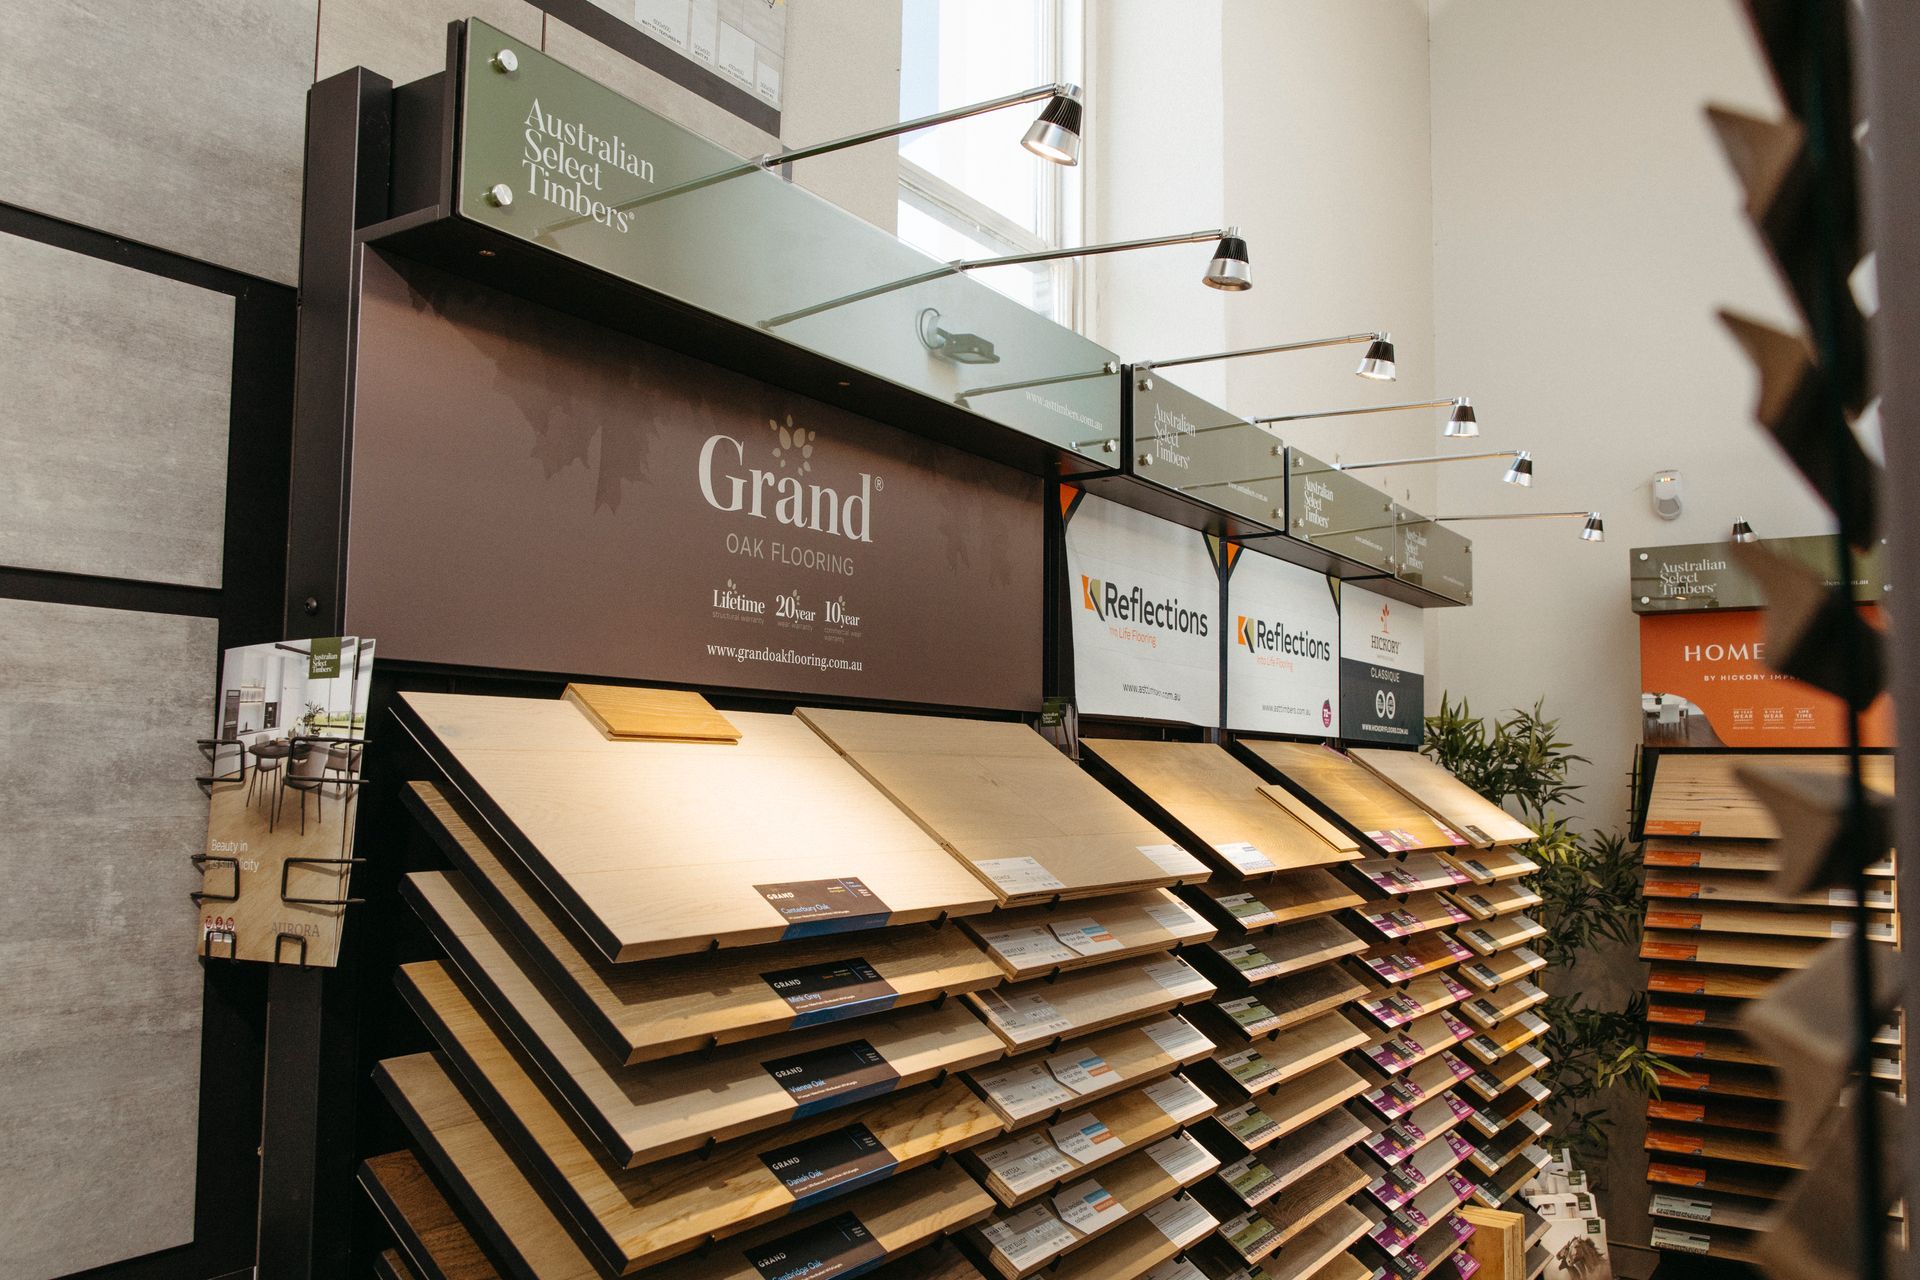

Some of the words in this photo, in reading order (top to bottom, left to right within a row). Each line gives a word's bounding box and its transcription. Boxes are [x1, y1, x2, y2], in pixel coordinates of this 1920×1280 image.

[524, 98, 655, 184] Australian
[525, 129, 603, 191] Select
[1154, 403, 1196, 438] Australian
[1154, 421, 1179, 449] Select
[1304, 475, 1334, 501] Australian
[1304, 491, 1322, 511] Select
[726, 533, 764, 559] OAK
[771, 542, 854, 576] FLOORING
[1660, 559, 1726, 573] Australian
[1660, 572, 1698, 584] Select
[713, 589, 765, 614] Lifetime
[1105, 581, 1208, 637] Reflections
[1257, 619, 1330, 662] Reflections
[1371, 635, 1400, 655] HICKORY
[706, 644, 863, 672] www.grandoakflooring.com.au
[1685, 643, 1766, 662] HOME
[1370, 666, 1400, 683] CLASSIQUE
[211, 839, 238, 854] Beauty
[240, 840, 248, 852] in
[766, 892, 794, 900] GRAND
[774, 979, 802, 989] GRAND
[775, 1067, 803, 1078] GRAND
[789, 1082, 812, 1093] Vienna
[812, 1079, 826, 1088] Oak
[772, 1157, 800, 1171] GRAND
[786, 1172, 808, 1187] Danish
[808, 1169, 824, 1180] Oak
[757, 1252, 786, 1268] GRAND
[808, 1260, 823, 1269] Oak
